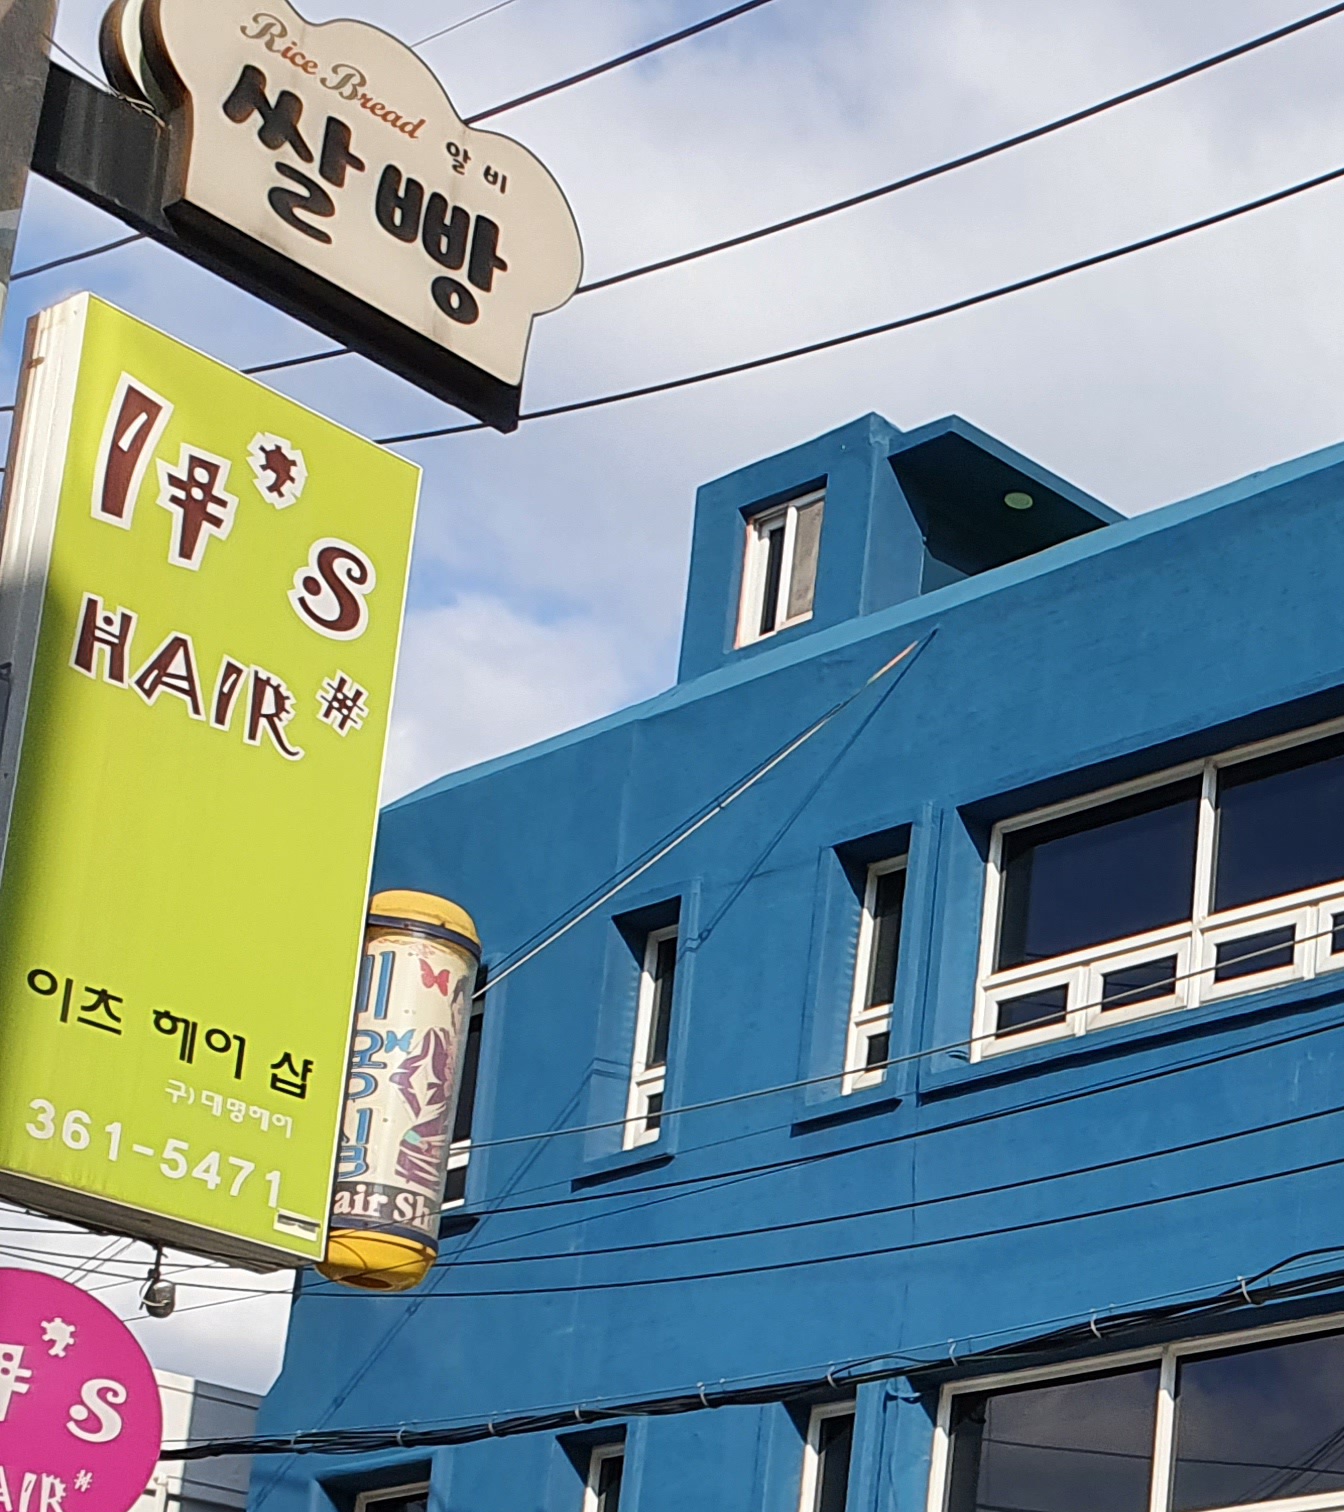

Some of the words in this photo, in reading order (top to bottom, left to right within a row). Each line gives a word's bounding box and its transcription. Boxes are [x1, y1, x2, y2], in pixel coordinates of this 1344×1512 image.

[240, 12, 318, 75] Rice
[320, 63, 427, 139] Bread
[222, 64, 508, 325] 쌀빵
[69, 592, 304, 761] HAIR
[27, 968, 123, 1036] 이츠
[270, 1051, 314, 1100] 샵
[26, 1098, 281, 1208] 361-5471
